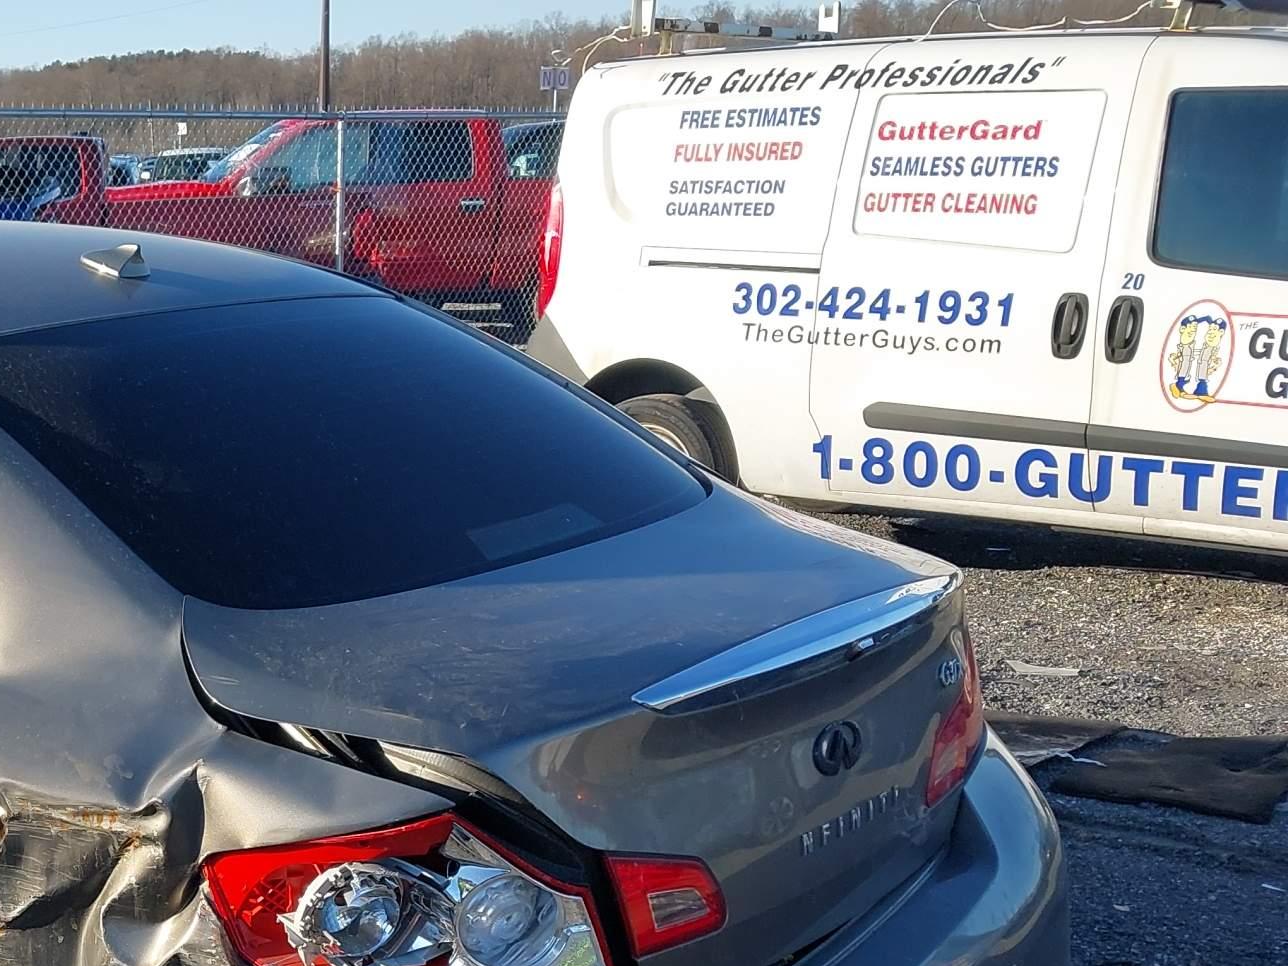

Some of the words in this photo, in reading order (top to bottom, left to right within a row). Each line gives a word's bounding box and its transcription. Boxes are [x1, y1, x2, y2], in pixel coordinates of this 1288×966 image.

[542, 71, 552, 87] N
[719, 67, 814, 95] Gutter
[679, 108, 722, 130] FREE
[725, 105, 822, 128] ESTIMATES
[877, 119, 1044, 142] GutterGard
[673, 143, 724, 163] FULLY
[727, 140, 804, 162] INSURED
[869, 156, 965, 178] SEAMLESS
[970, 155, 1060, 178] GUTTERS
[668, 179, 786, 195] SATISFACTION
[665, 201, 776, 218] GUARANTEED
[863, 192, 936, 214] GUTTER
[940, 192, 1039, 216] CLEANING
[1121, 272, 1146, 291] 20
[732, 281, 1015, 328] 302-424-1931
[1239, 321, 1259, 331] THE
[741, 322, 1003, 355] TheGutterGuys.com
